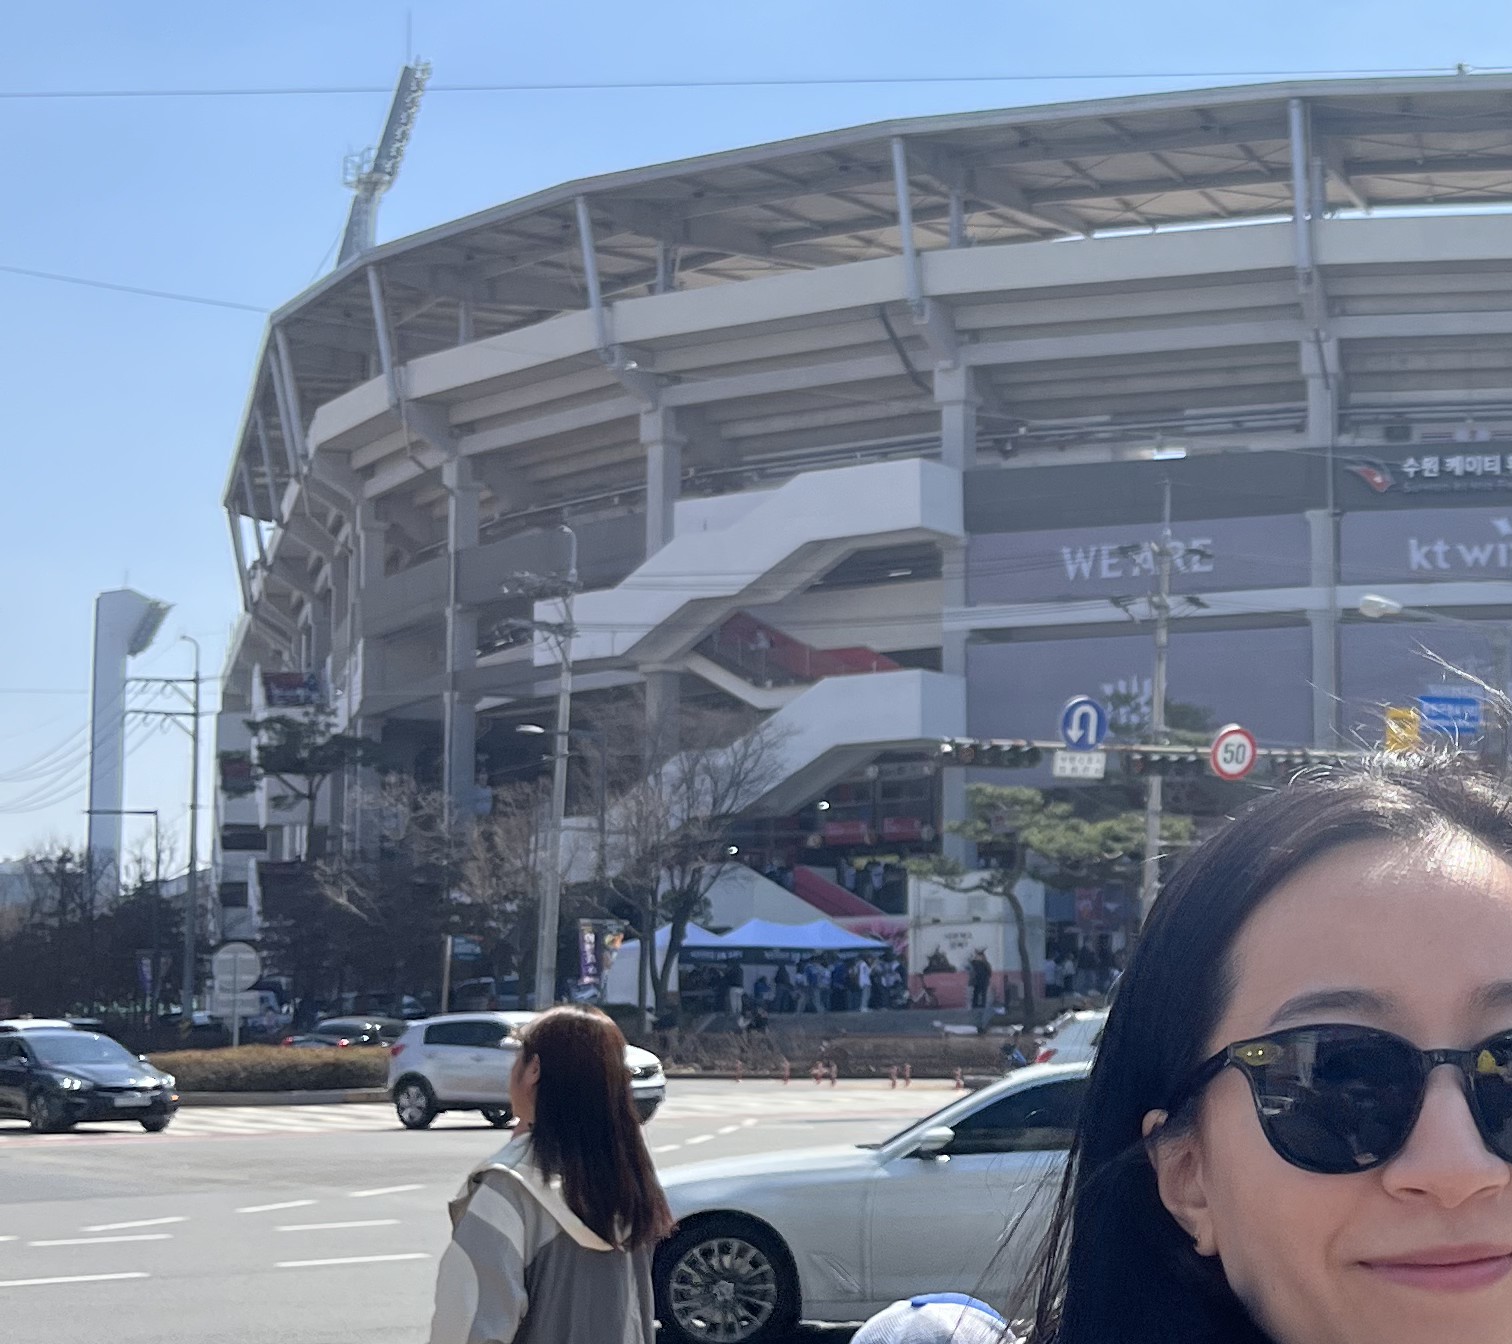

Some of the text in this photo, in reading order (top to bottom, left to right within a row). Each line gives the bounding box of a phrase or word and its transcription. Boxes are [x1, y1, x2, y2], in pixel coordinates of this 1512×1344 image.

[1403, 456, 1440, 477] 수원
[1446, 455, 1500, 476] 케이티
[1062, 543, 1122, 582] WE
[1408, 538, 1450, 570] kt
[1222, 742, 1248, 765] 50
